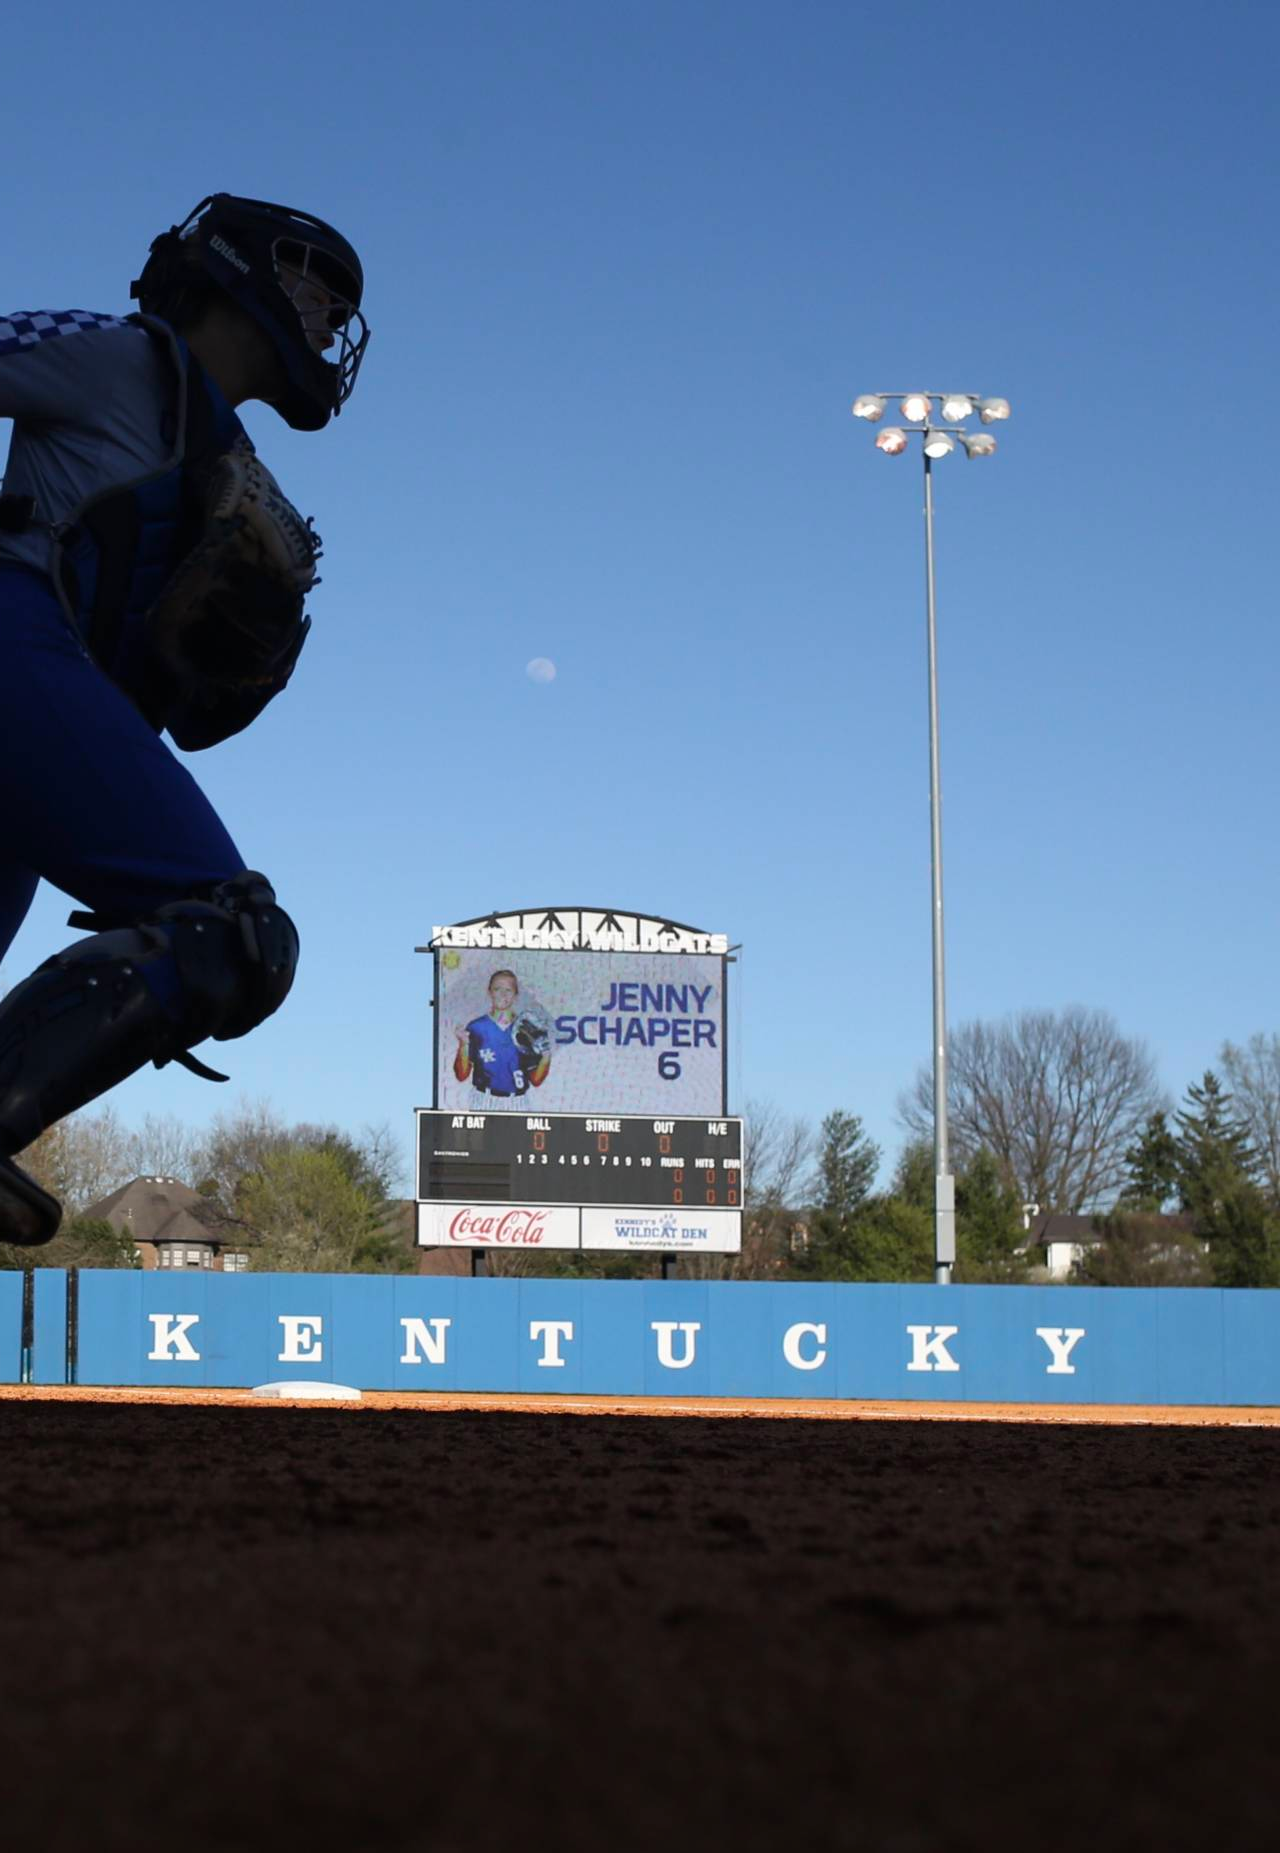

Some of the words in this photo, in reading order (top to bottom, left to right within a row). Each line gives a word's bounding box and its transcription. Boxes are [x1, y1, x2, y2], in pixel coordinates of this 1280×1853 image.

[209, 234, 250, 275] Wilson
[431, 926, 580, 950] KENTUCKY
[585, 930, 729, 955] WILDCATS
[601, 982, 713, 1014] JENNY
[555, 1015, 717, 1049] SCHAPER
[657, 1051, 682, 1080] 6
[513, 1070, 524, 1089] 6
[452, 1116, 464, 1129] AT
[467, 1116, 486, 1129] BAT
[527, 1118, 551, 1131] BALL
[585, 1119, 621, 1133] STRIKE
[653, 1121, 675, 1134] OUT
[708, 1122, 727, 1135] H/E
[517, 1154, 522, 1164] 1
[529, 1154, 536, 1164] 2
[541, 1154, 548, 1164] 3
[559, 1155, 565, 1165] 4
[571, 1155, 577, 1165] 5
[583, 1156, 590, 1165] 6
[600, 1156, 607, 1165] 7
[613, 1156, 619, 1166] 8
[625, 1156, 632, 1166] 9
[640, 1157, 652, 1167] 10
[660, 1157, 684, 1168] RUNS
[695, 1158, 715, 1169] HITS
[723, 1159, 741, 1169] ERR
[449, 1208, 551, 1244] Coca-Cola
[615, 1226, 678, 1239] WILDCAT
[681, 1228, 708, 1239] DEN
[148, 1313, 1085, 1374] KENTUCKY
